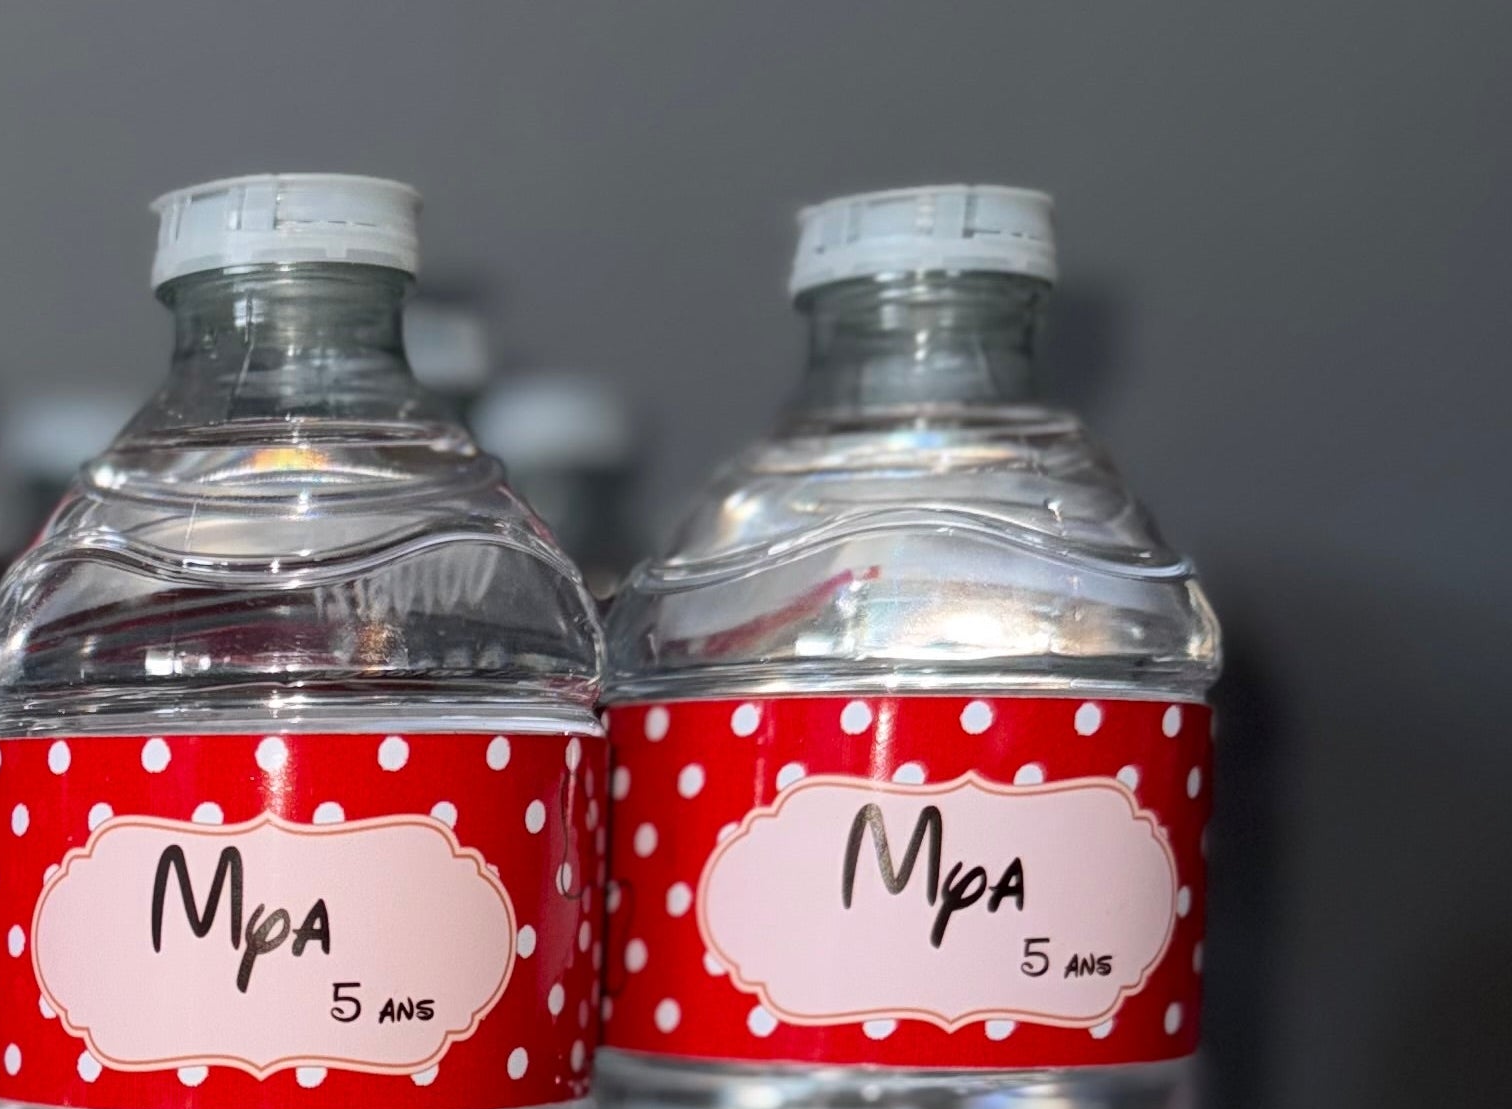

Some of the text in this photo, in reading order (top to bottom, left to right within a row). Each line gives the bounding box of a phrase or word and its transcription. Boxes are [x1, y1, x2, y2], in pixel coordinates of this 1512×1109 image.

[1020, 937, 1113, 979] 5 ANS
[330, 982, 435, 1025] 5 ANS
